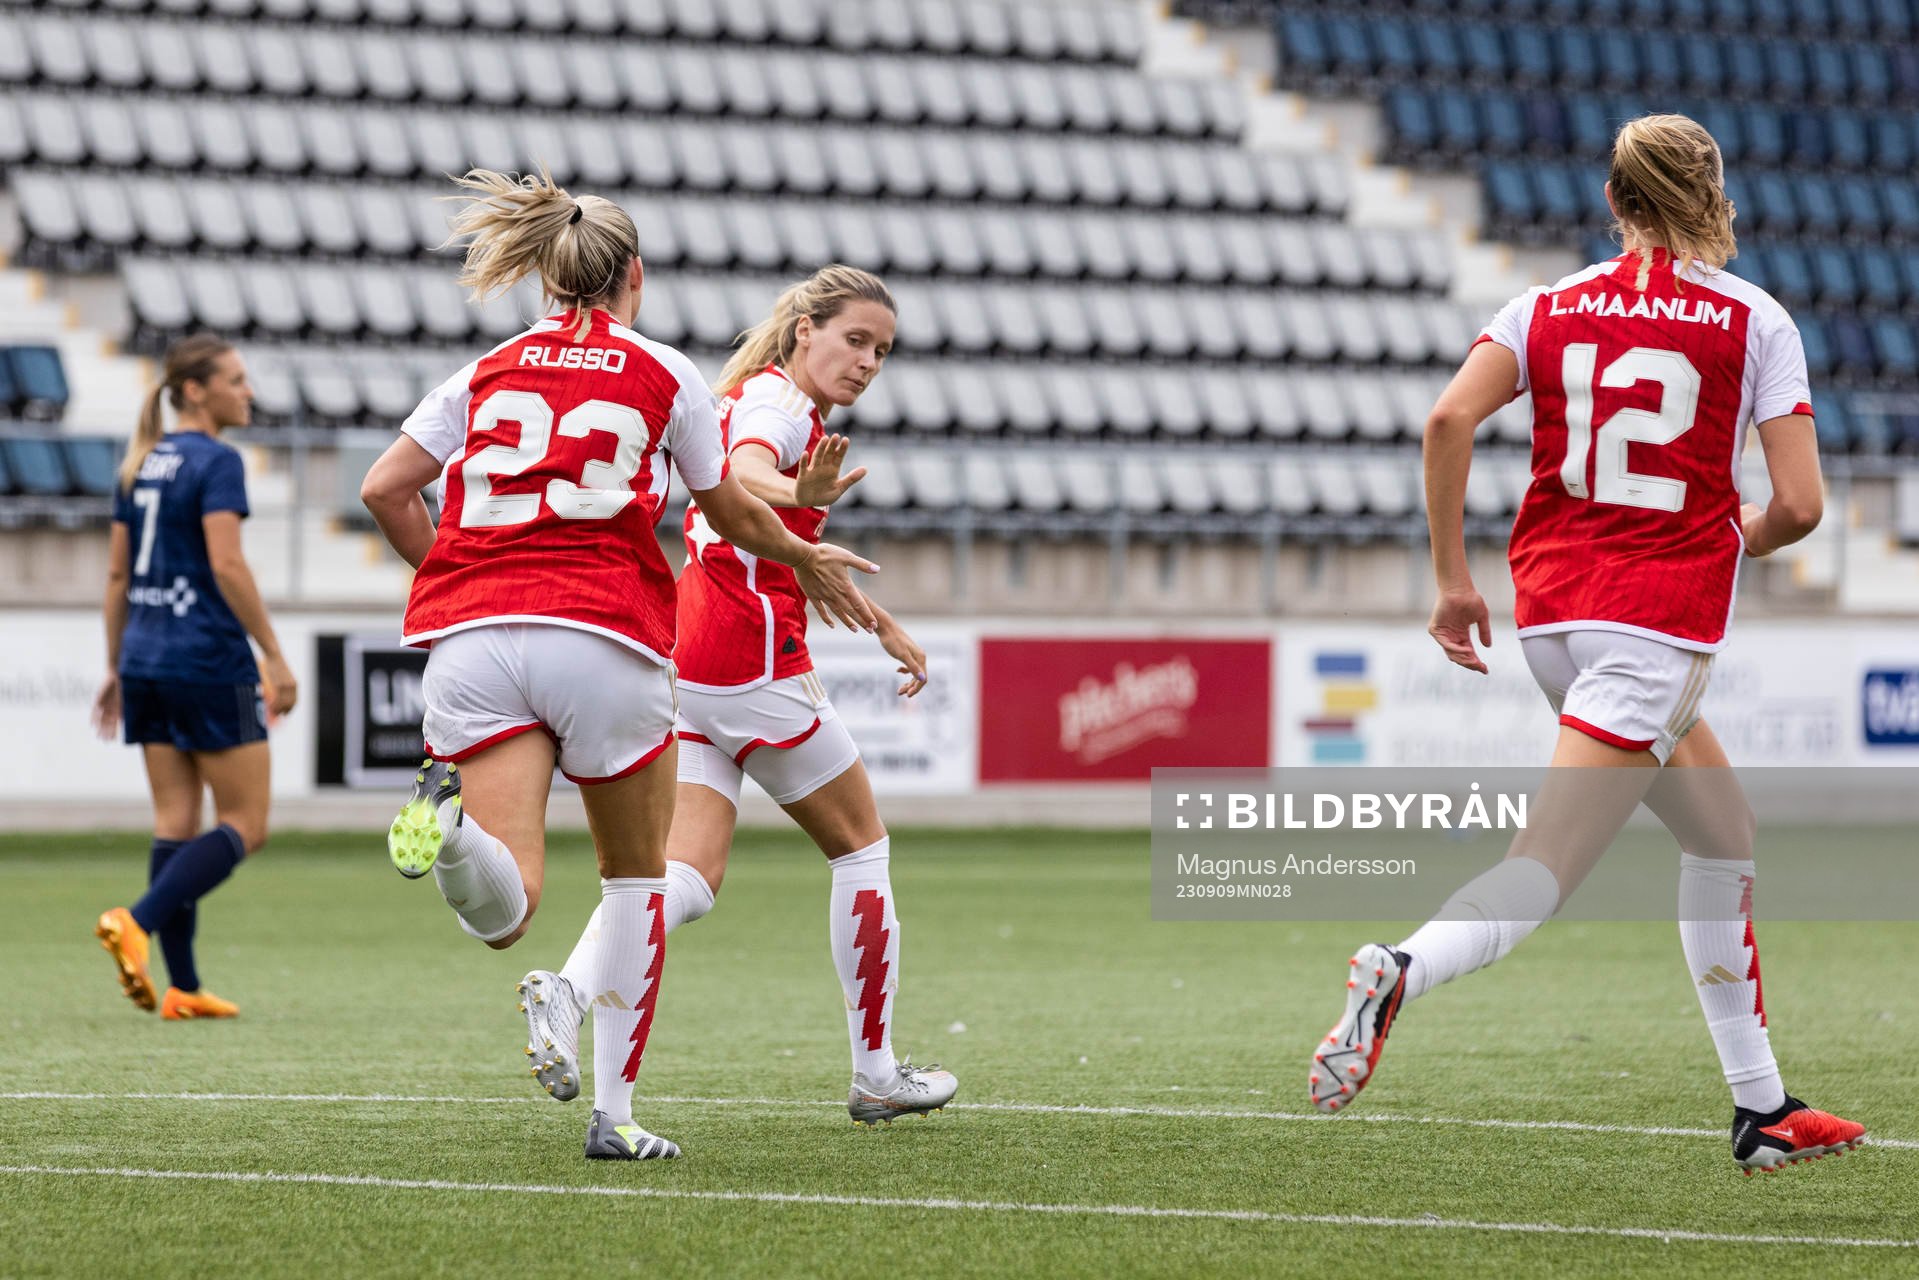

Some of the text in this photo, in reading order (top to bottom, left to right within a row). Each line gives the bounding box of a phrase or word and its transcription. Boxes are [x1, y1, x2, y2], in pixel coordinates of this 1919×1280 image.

[1549, 292, 1732, 331] L.MAANUM
[518, 345, 628, 375] RUSSO
[459, 389, 650, 529] 23
[1560, 342, 1701, 513] 12
[133, 487, 161, 577] 7
